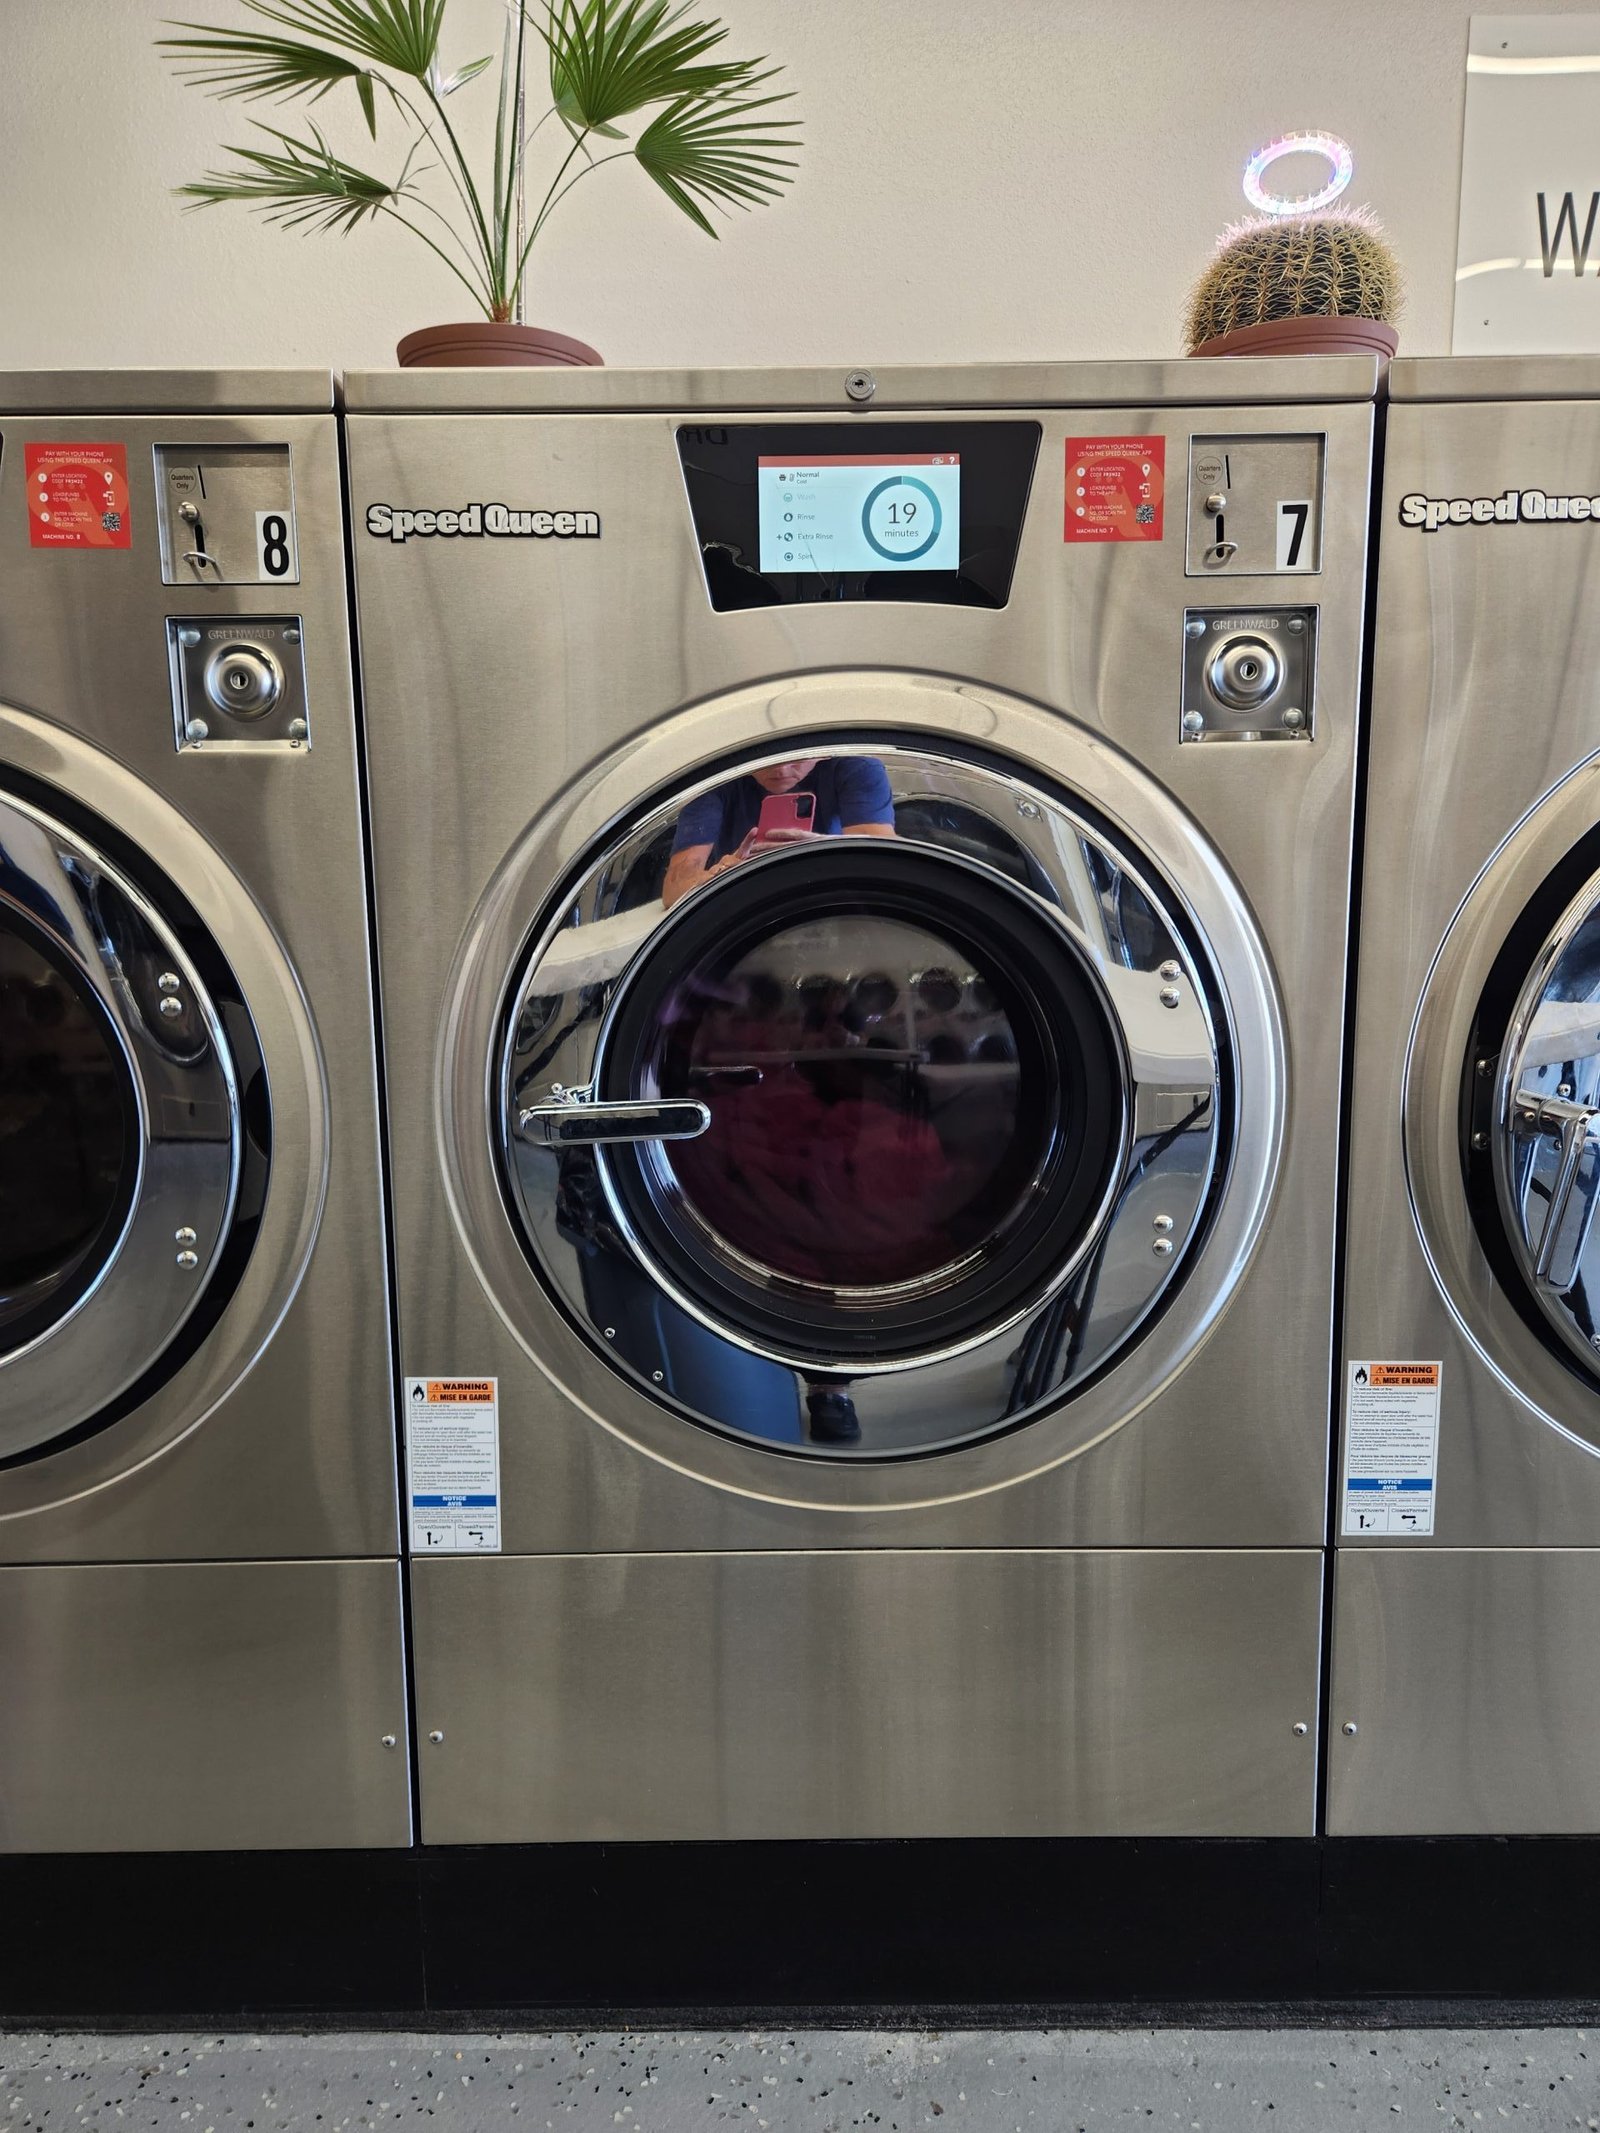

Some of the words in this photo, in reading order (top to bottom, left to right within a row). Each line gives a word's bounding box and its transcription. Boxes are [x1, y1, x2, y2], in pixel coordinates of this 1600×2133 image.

[1536, 192, 1600, 278] W
[176, 482, 189, 490] Only
[888, 503, 917, 524] 19
[884, 528, 918, 537] minutes
[1282, 504, 1308, 566] 7
[263, 515, 289, 576] 8
[1212, 619, 1279, 631] GREENWALD
[208, 629, 275, 640] GREENWALD
